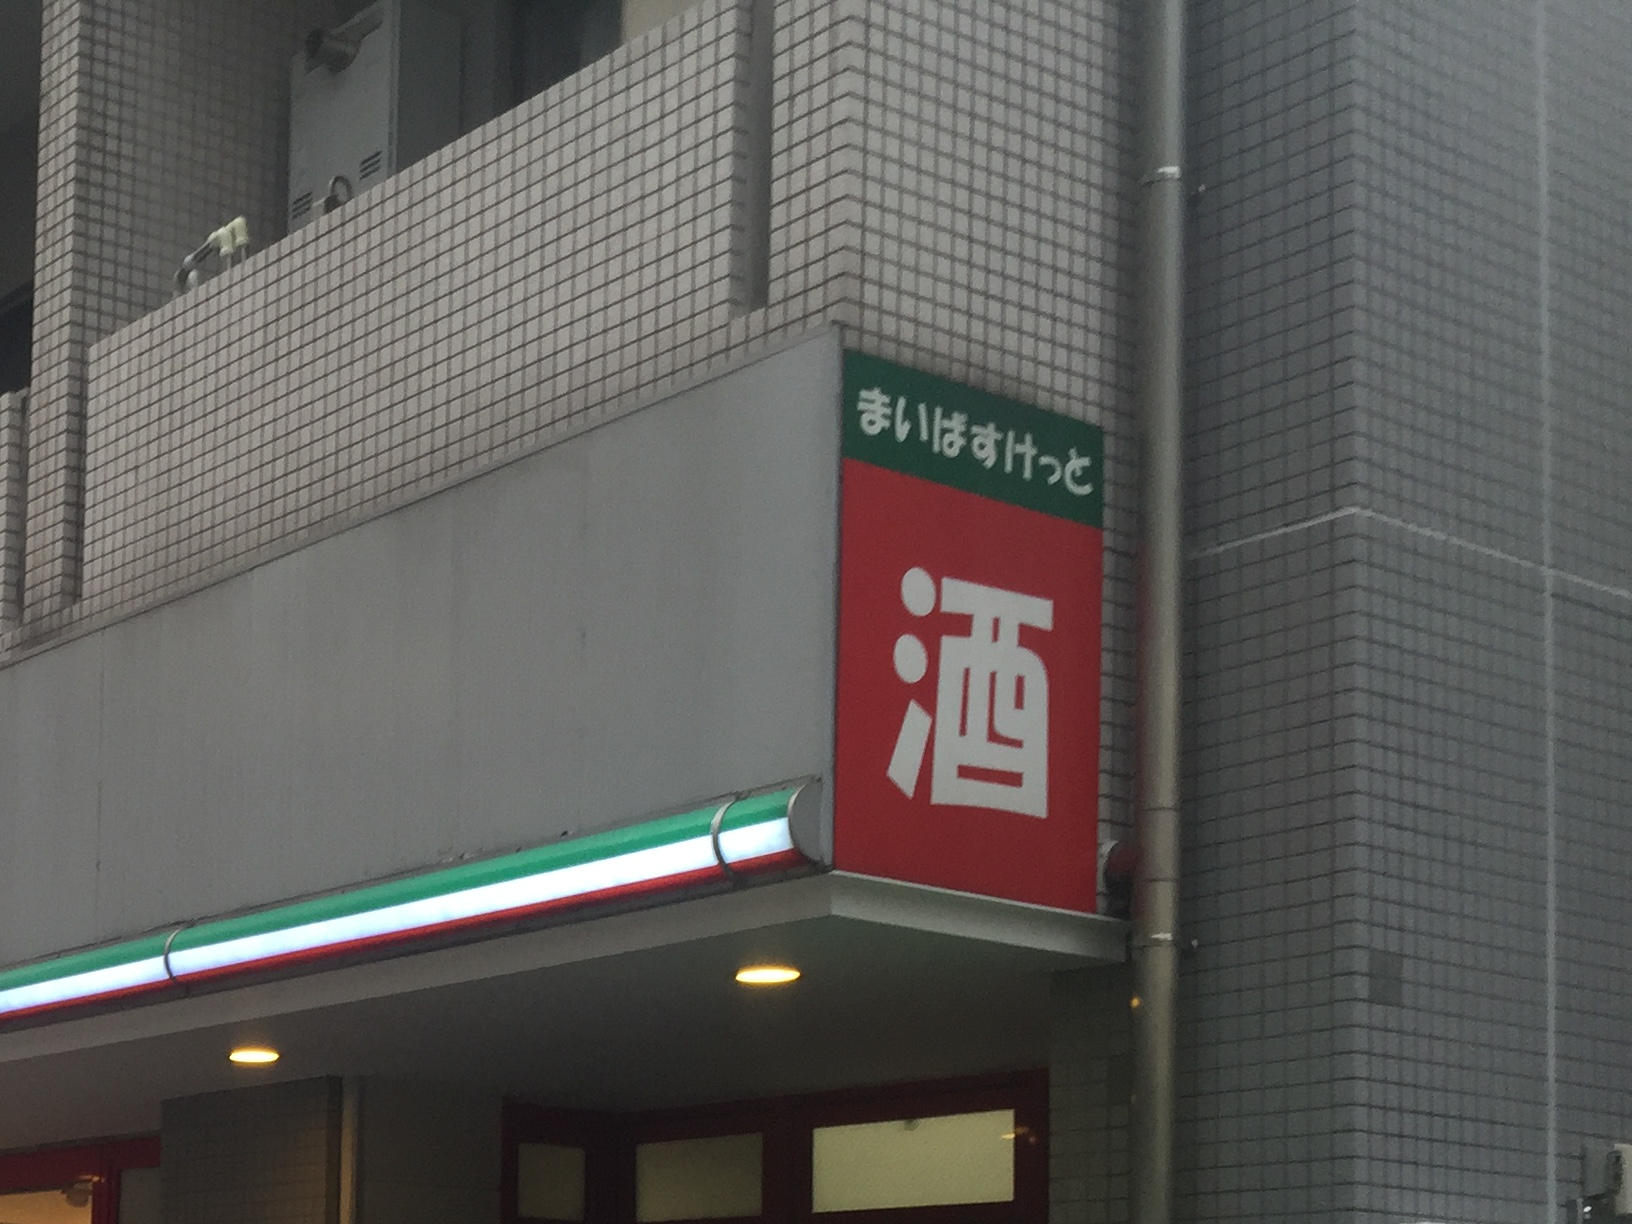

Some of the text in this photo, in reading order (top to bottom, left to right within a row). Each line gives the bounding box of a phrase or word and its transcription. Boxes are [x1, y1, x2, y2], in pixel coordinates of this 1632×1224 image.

[856, 386, 1094, 496] まいばすけっと
[885, 566, 1055, 820] 酒
